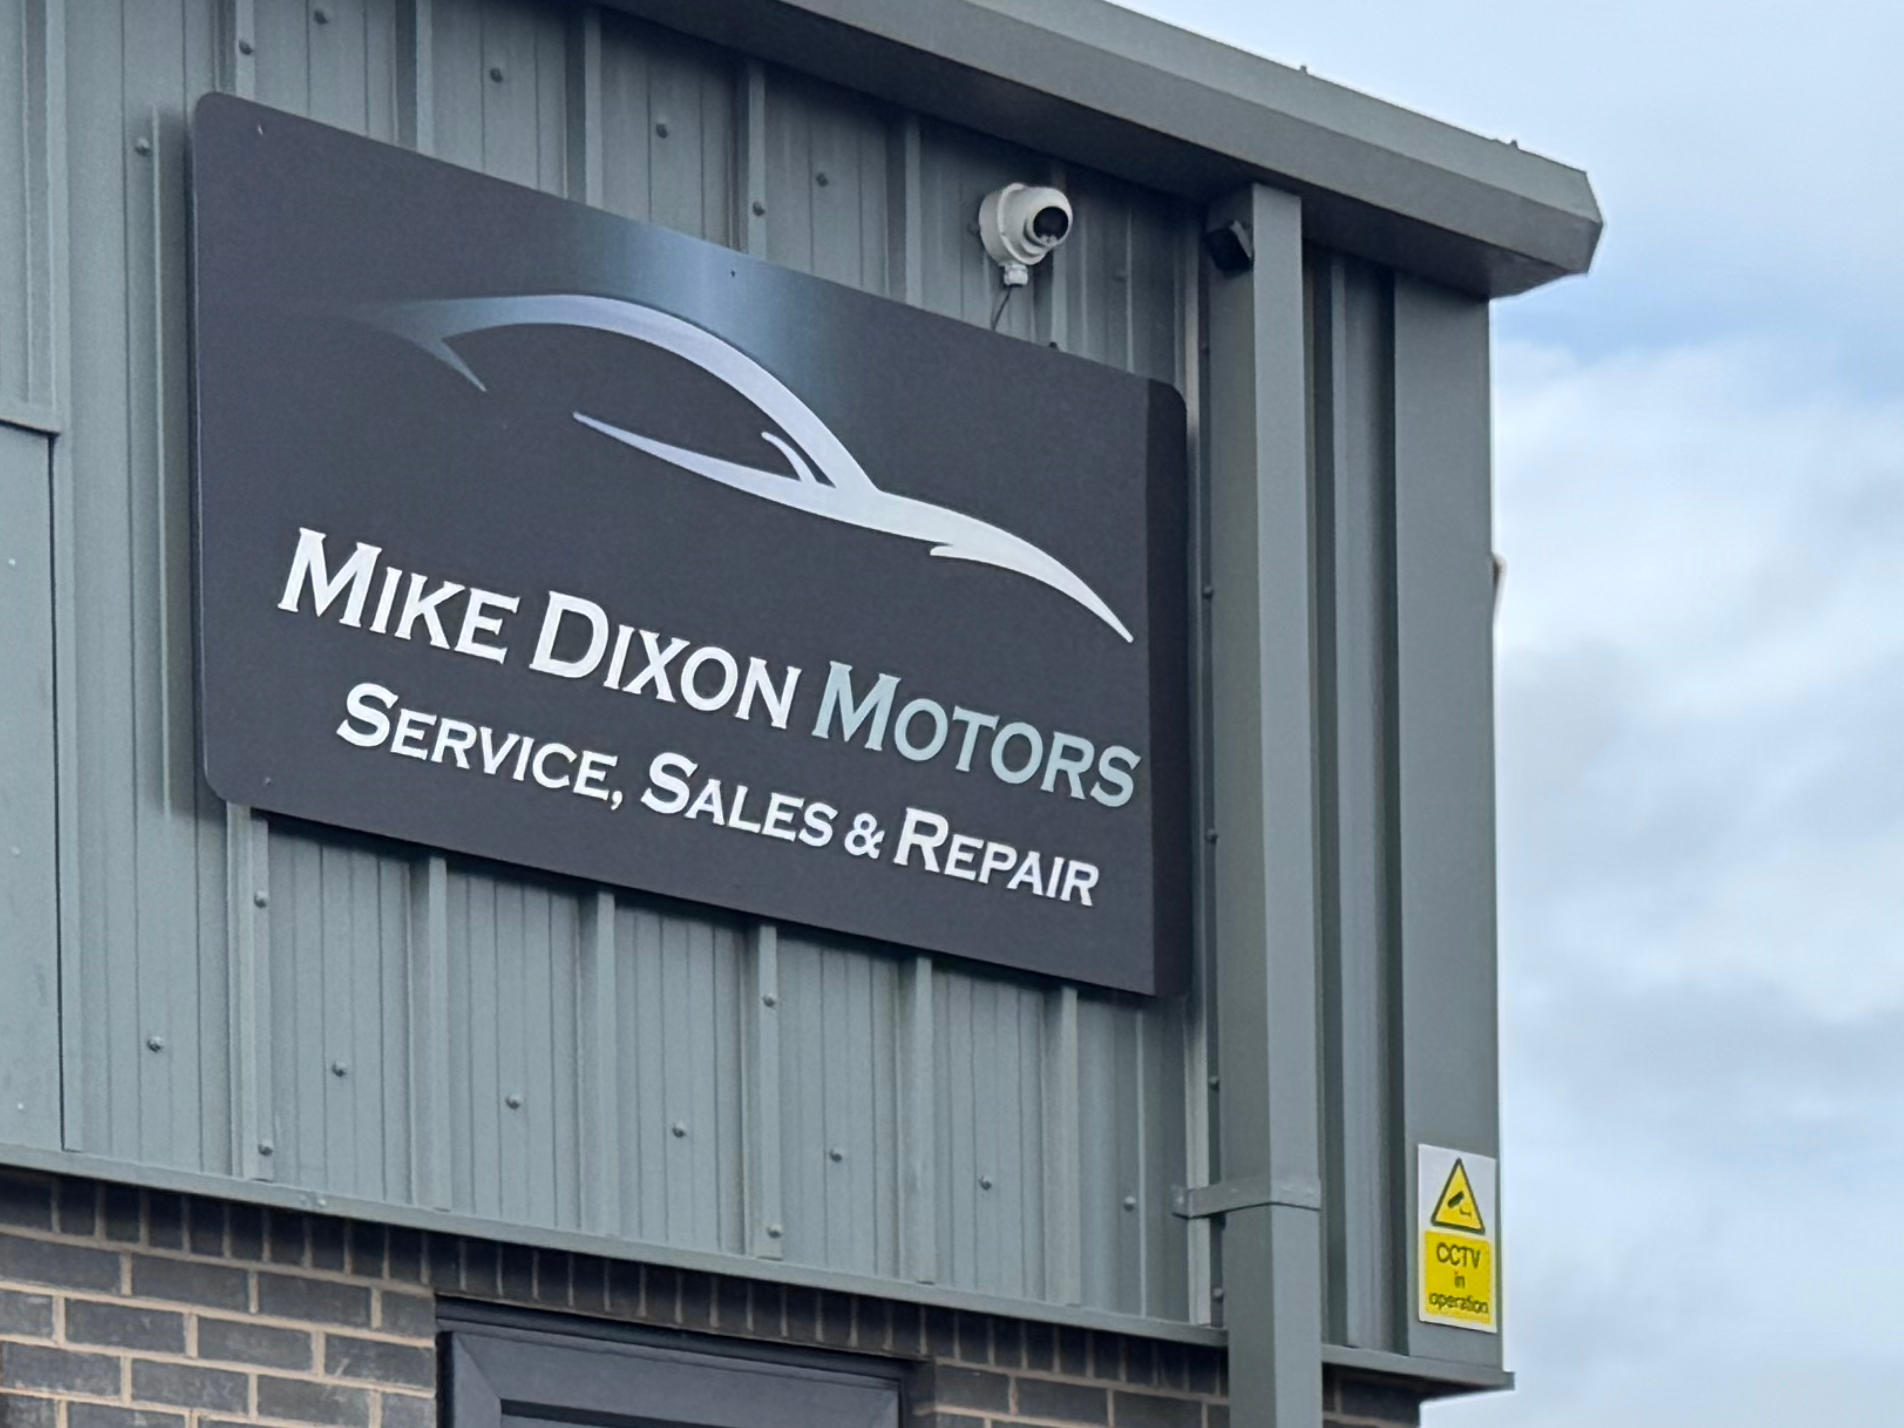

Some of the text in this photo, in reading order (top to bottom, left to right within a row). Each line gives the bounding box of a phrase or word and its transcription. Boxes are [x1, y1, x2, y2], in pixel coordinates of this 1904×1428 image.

[277, 526, 1141, 807] MIKE DIXON MOTORS
[336, 682, 1099, 906] SERVICE, SALES & REPAIR
[1436, 1242, 1481, 1268] CCTV
[1454, 1271, 1465, 1289] in
[1428, 1293, 1489, 1314] operation
